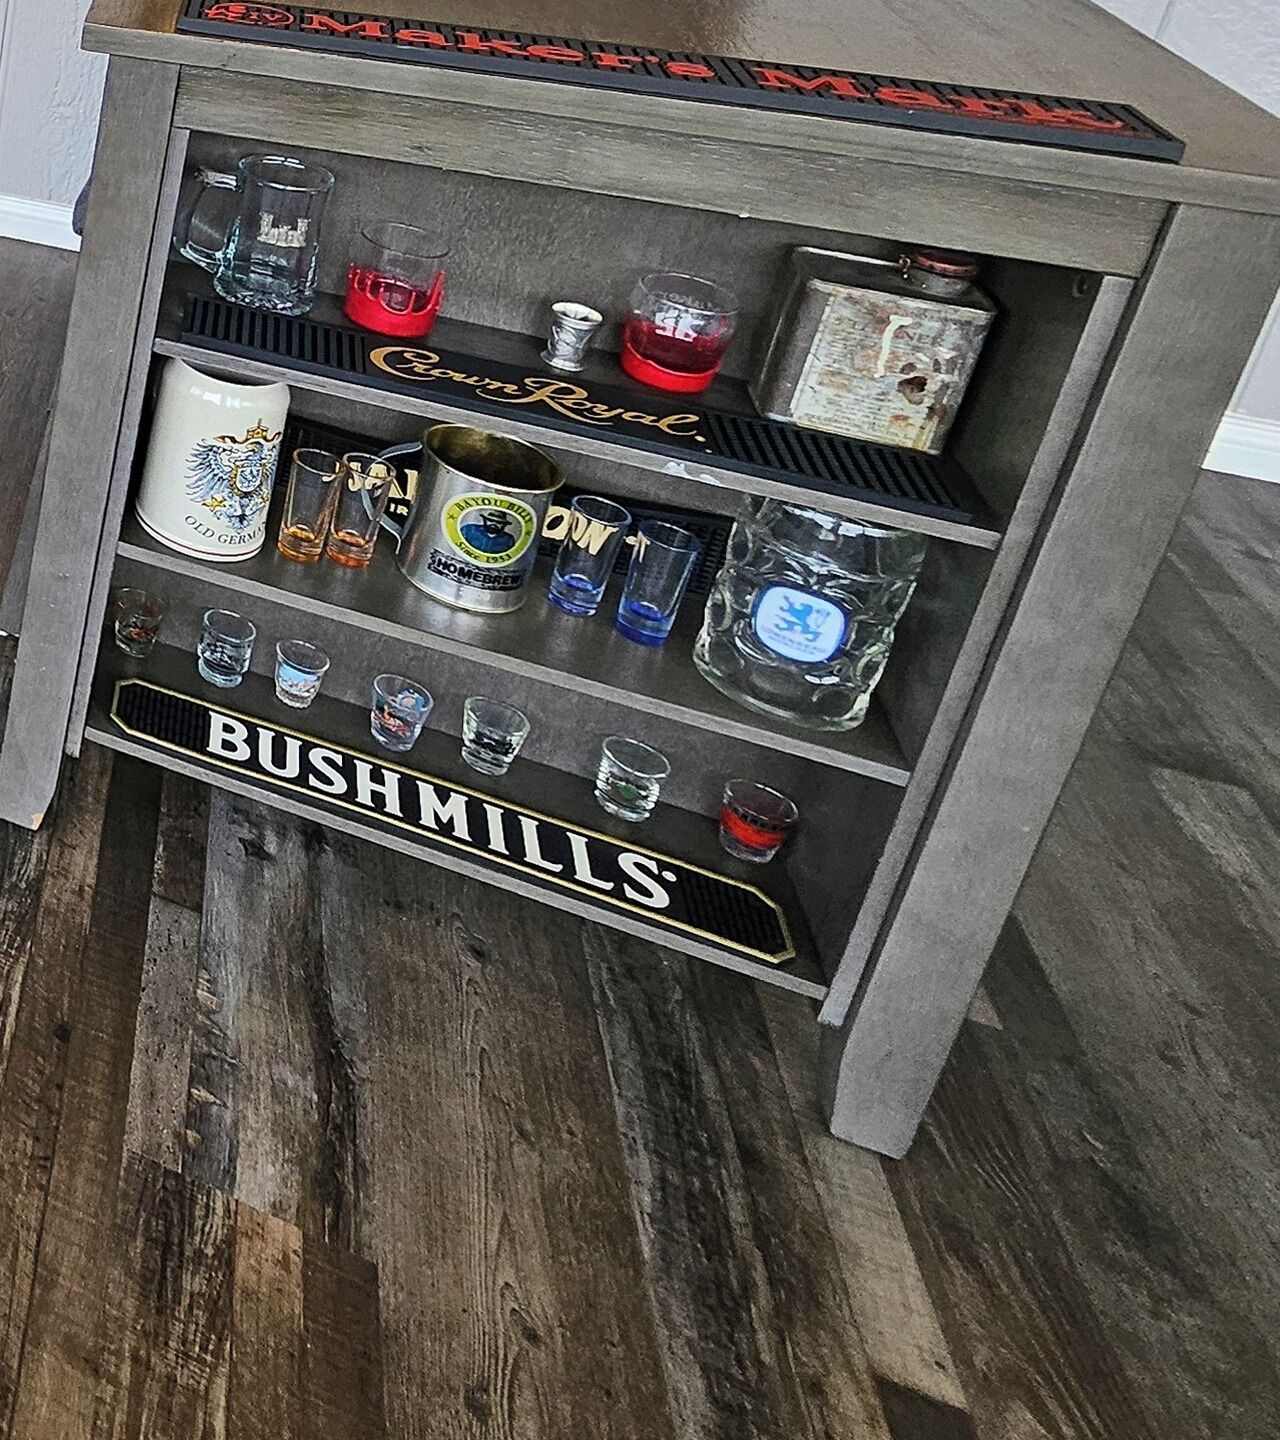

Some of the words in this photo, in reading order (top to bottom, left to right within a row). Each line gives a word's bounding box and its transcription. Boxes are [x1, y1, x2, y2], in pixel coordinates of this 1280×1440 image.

[300, 13, 715, 78] Maker's
[752, 66, 1127, 130] Mark
[369, 345, 523, 395] Crown
[184, 515, 215, 538] OLD
[454, 496, 504, 512] BAYOU
[506, 502, 534, 523] BILLY
[435, 557, 522, 586] HOMEBREW
[205, 710, 672, 909] BUSHMILLS
